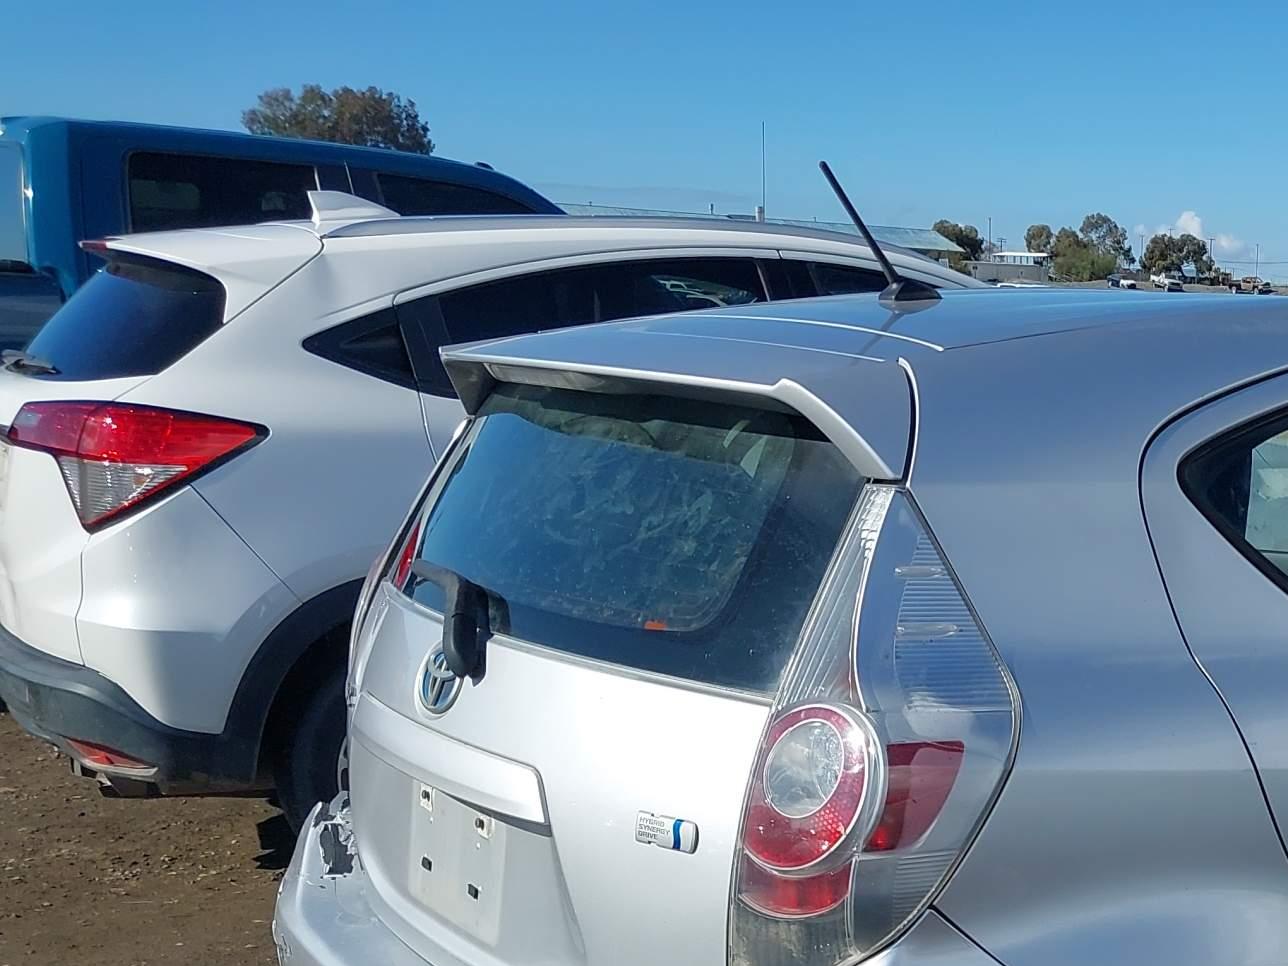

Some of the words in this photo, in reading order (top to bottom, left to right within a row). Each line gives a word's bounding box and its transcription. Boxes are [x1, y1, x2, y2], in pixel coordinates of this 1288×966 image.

[639, 816, 665, 828] HYBRID
[637, 830, 657, 840] DRIVE
[638, 823, 670, 836] SYNERGY
